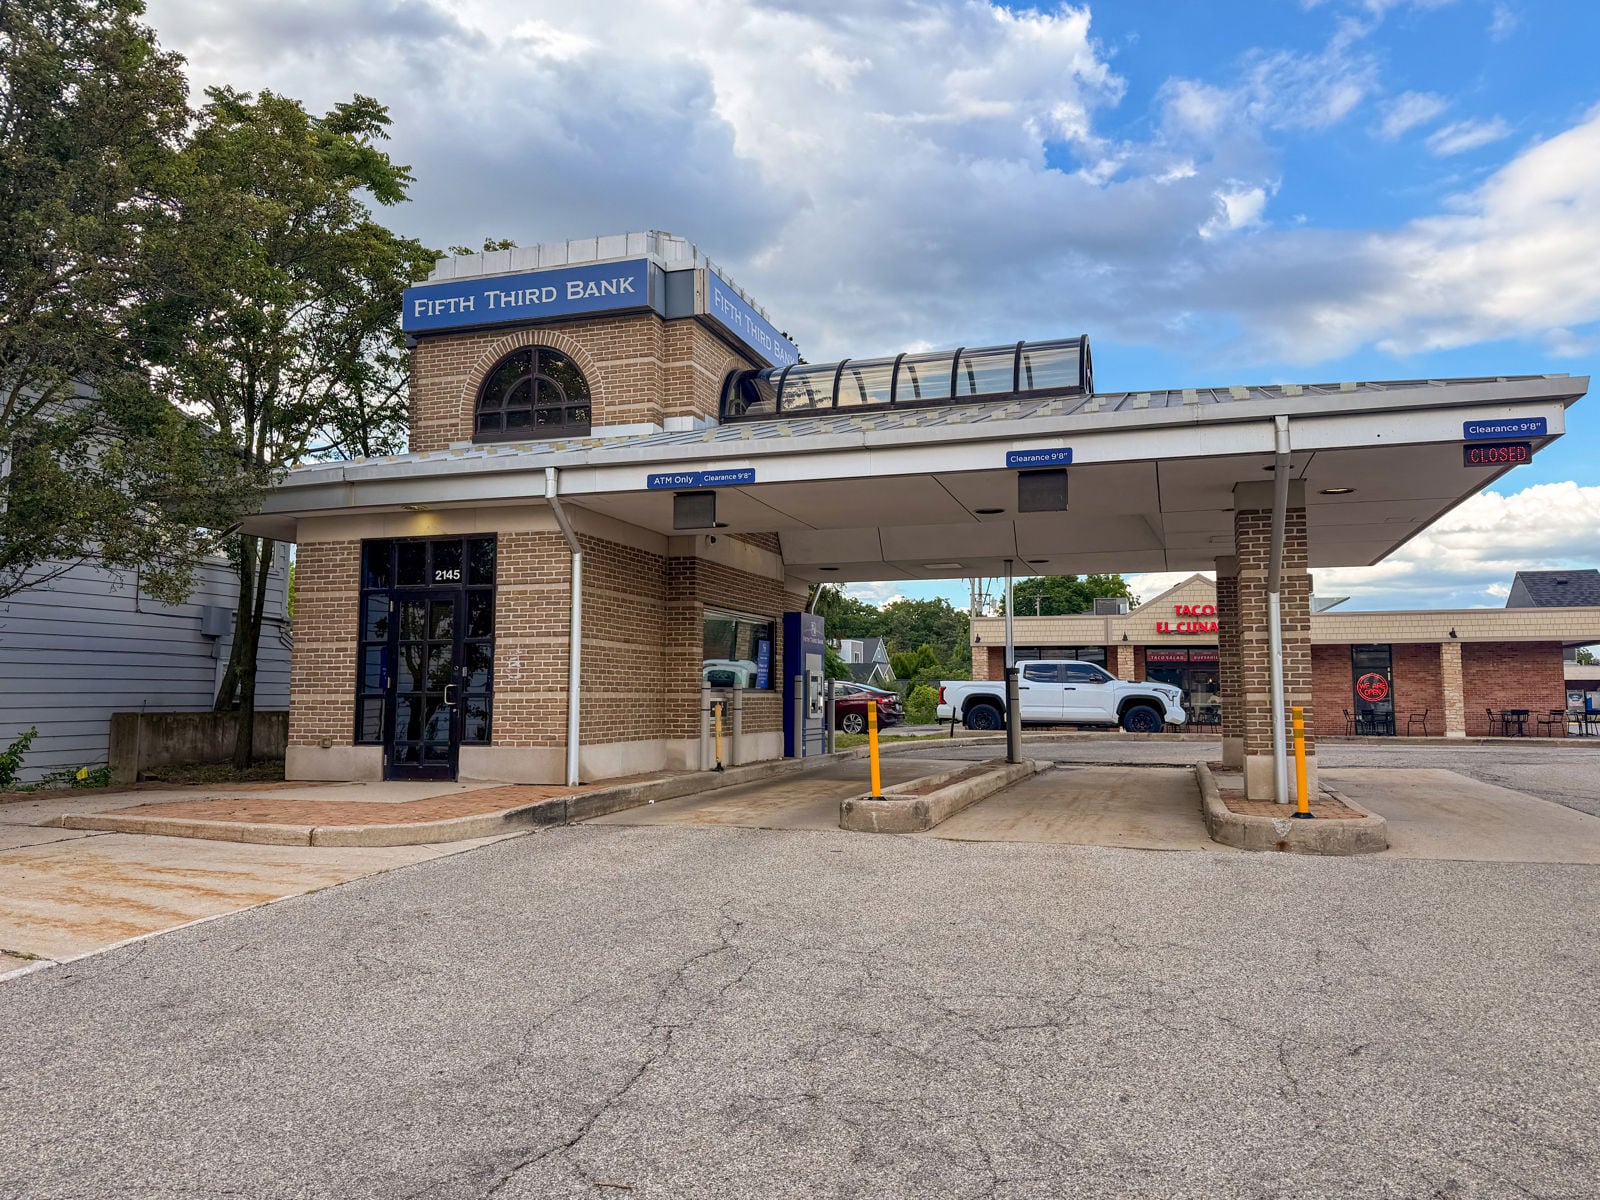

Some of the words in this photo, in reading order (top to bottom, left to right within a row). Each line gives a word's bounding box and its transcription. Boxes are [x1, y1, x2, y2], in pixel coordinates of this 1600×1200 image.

[414, 295, 475, 318] FIFTH
[484, 286, 558, 309] THIRD
[566, 276, 635, 300] BANK
[714, 287, 742, 326] FIFTH
[744, 314, 772, 350] THIRD
[1469, 423, 1519, 434] Clearance
[1520, 422, 1541, 431] 9'8"
[1010, 454, 1050, 463] Clearance
[1051, 452, 1068, 460] 9'8"
[1470, 446, 1527, 463] CLOSED
[653, 476, 673, 485] ATM
[674, 475, 694, 485] Only
[703, 473, 737, 482] Clearance
[737, 472, 752, 480] 9'8"
[435, 569, 461, 581] 2145
[1174, 604, 1219, 617] TACO
[1156, 621, 1172, 634] EL
[1364, 688, 1382, 696] OPEN
